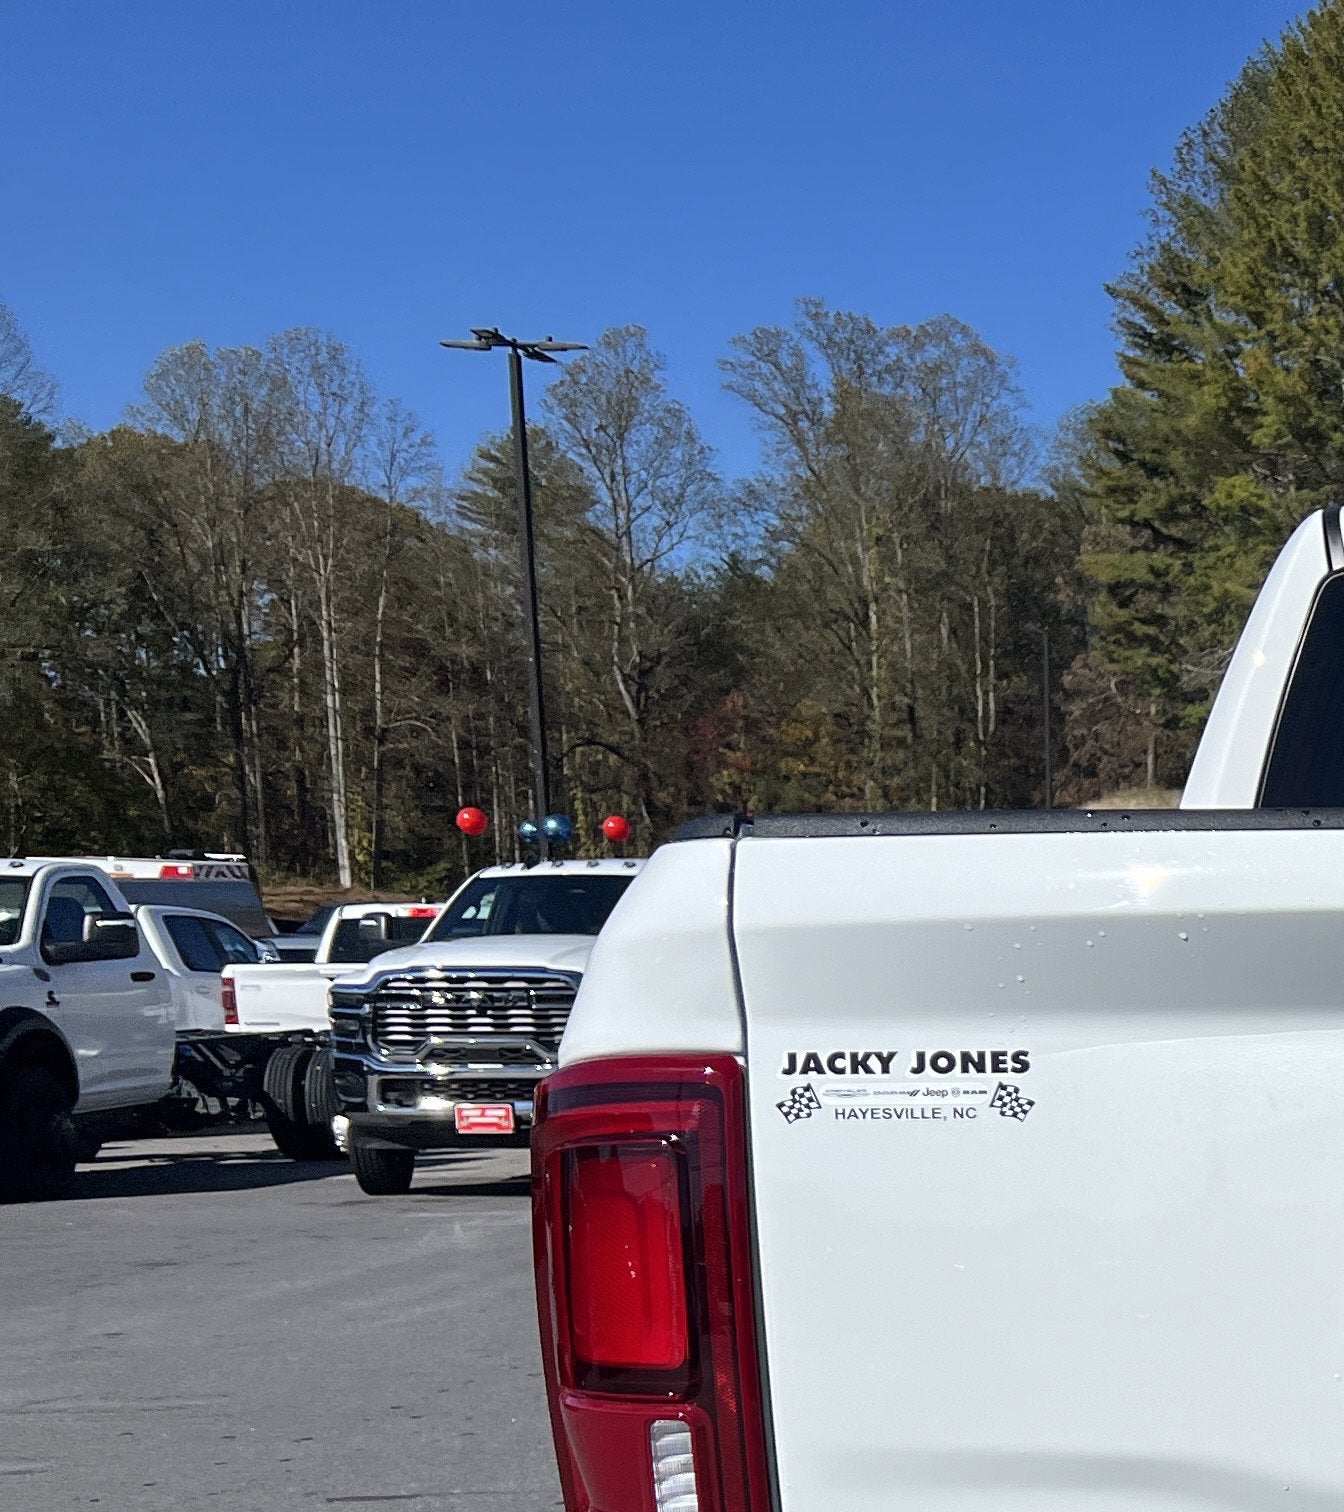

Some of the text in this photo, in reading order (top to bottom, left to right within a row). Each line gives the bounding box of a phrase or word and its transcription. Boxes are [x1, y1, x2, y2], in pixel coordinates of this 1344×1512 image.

[781, 1050, 1031, 1075] JACKY JONES
[921, 1087, 949, 1098] Jeep
[834, 1107, 977, 1121] HAYESVILLE, NC
